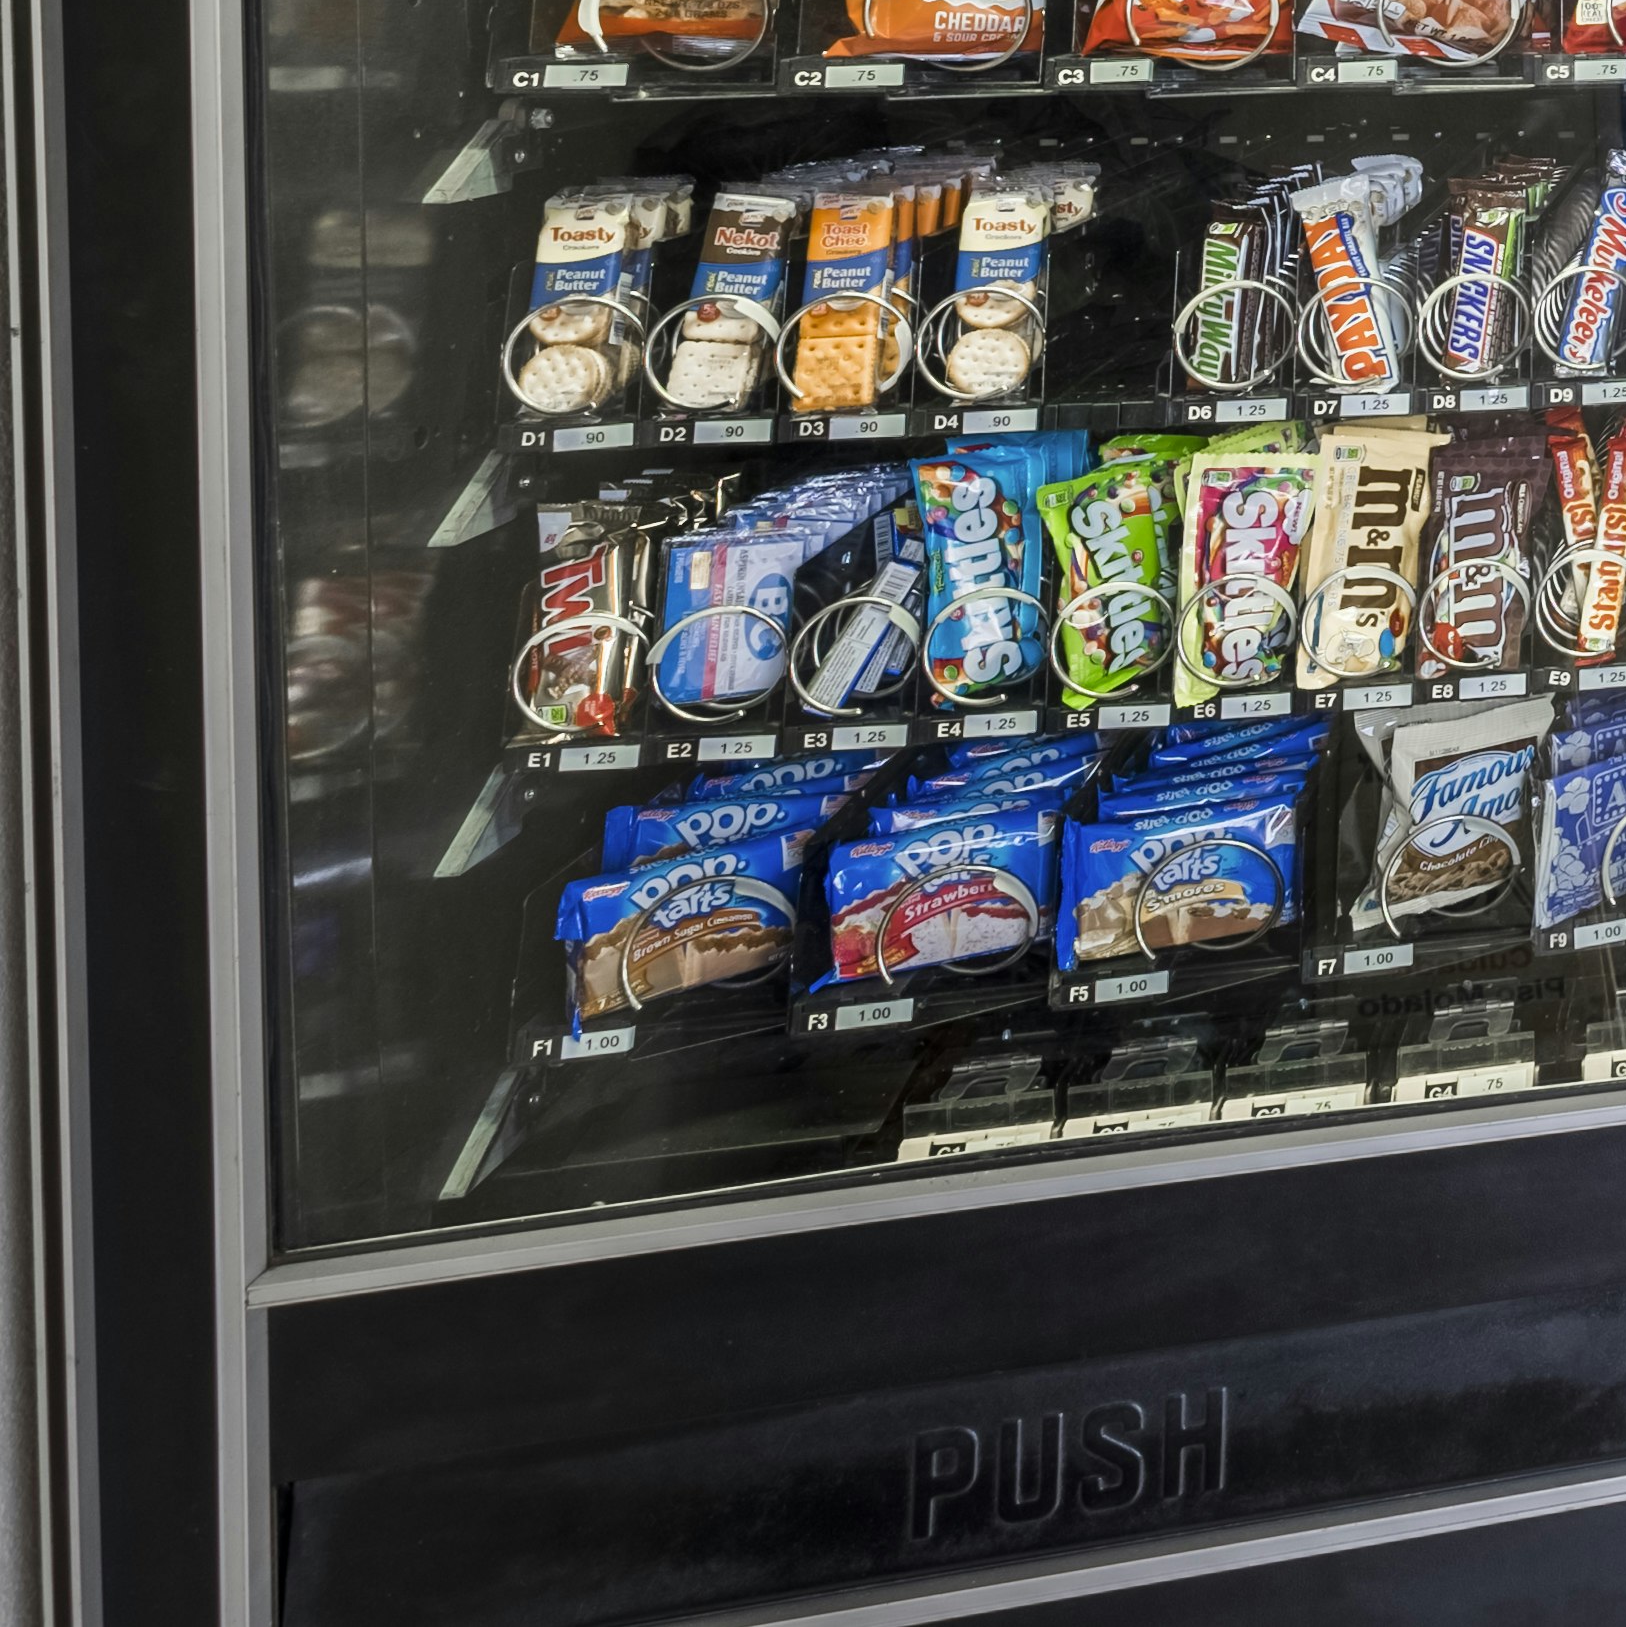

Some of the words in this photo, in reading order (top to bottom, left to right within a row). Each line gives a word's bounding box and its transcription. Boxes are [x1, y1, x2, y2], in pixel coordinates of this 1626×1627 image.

[934, 10, 1025, 33] CHEDDAR
[946, 32, 977, 43] SOUR
[512, 71, 540, 87] C1
[572, 69, 600, 82] .75
[794, 71, 822, 86] C2
[1058, 68, 1085, 85] C3
[1310, 67, 1336, 82] C4
[1546, 65, 1570, 79] C5
[550, 226, 616, 244] Toasty
[822, 223, 871, 237] Toast
[972, 217, 1038, 235] Toasty
[714, 227, 781, 249] Nekot
[820, 235, 869, 248] Chee
[981, 256, 1030, 268] Peanut
[555, 269, 606, 281] Peanut
[716, 271, 768, 285] Peanut
[822, 266, 872, 278] Peanut
[980, 266, 1025, 279] Butter
[554, 279, 600, 291] Butter
[714, 283, 761, 296] Butter
[821, 277, 866, 289] Butter
[1303, 216, 1390, 382] PAYDAY
[1449, 232, 1496, 361] SNICKERS
[1189, 319, 1234, 380] Way
[1432, 394, 1456, 410] D8
[1549, 388, 1573, 403] D9
[1187, 406, 1212, 420] D6
[1237, 405, 1266, 416] 1.25
[1313, 399, 1338, 415] D7
[1360, 399, 1390, 411] 1.25
[799, 421, 824, 436] D3
[934, 414, 959, 429] D4
[520, 431, 546, 447] D1
[659, 426, 687, 442] D2
[1557, 449, 1575, 500] Original
[1607, 449, 1625, 501] Original
[1411, 473, 1424, 505] PEANUT
[945, 477, 1023, 683] Skittles
[1071, 500, 1152, 674] Skittles
[1221, 490, 1279, 680] Skittles
[748, 586, 790, 654] BC
[708, 632, 719, 663] RELIEF
[1548, 671, 1571, 686] E9
[1432, 684, 1454, 699] E8
[1478, 681, 1507, 693] 1.25
[1193, 703, 1217, 718] E6
[1241, 700, 1272, 713] 1.25
[1315, 694, 1338, 709] E7
[1363, 691, 1393, 703] 1.25
[937, 722, 962, 737] E4
[984, 718, 1017, 730] 1.25
[1066, 713, 1090, 728] E5
[1119, 711, 1150, 723] 1.25
[804, 733, 828, 748] E3
[853, 731, 887, 743] 1.25
[666, 743, 692, 759] E2
[720, 741, 753, 754] 1.25
[527, 752, 551, 768] E1
[583, 751, 617, 764] 1.25
[1408, 744, 1535, 826] Famous
[1429, 787, 1521, 849] Amo
[1419, 846, 1477, 872] Chocolate
[1153, 852, 1222, 893] tarts
[652, 881, 736, 928] tarts
[903, 880, 1003, 923] Strawberr
[632, 933, 672, 962] Brown
[673, 921, 705, 944] Sugar
[1549, 933, 1568, 949] F9
[1593, 925, 1622, 939] 1.00
[1317, 958, 1337, 976] F7
[1363, 952, 1394, 966] 1.00
[1068, 984, 1089, 1003] F5
[1115, 979, 1148, 994] 1.00
[807, 1012, 828, 1031] F3
[858, 1007, 891, 1021] 1.00
[532, 1038, 552, 1057] F1
[908, 1386, 1228, 1543] PUSH
